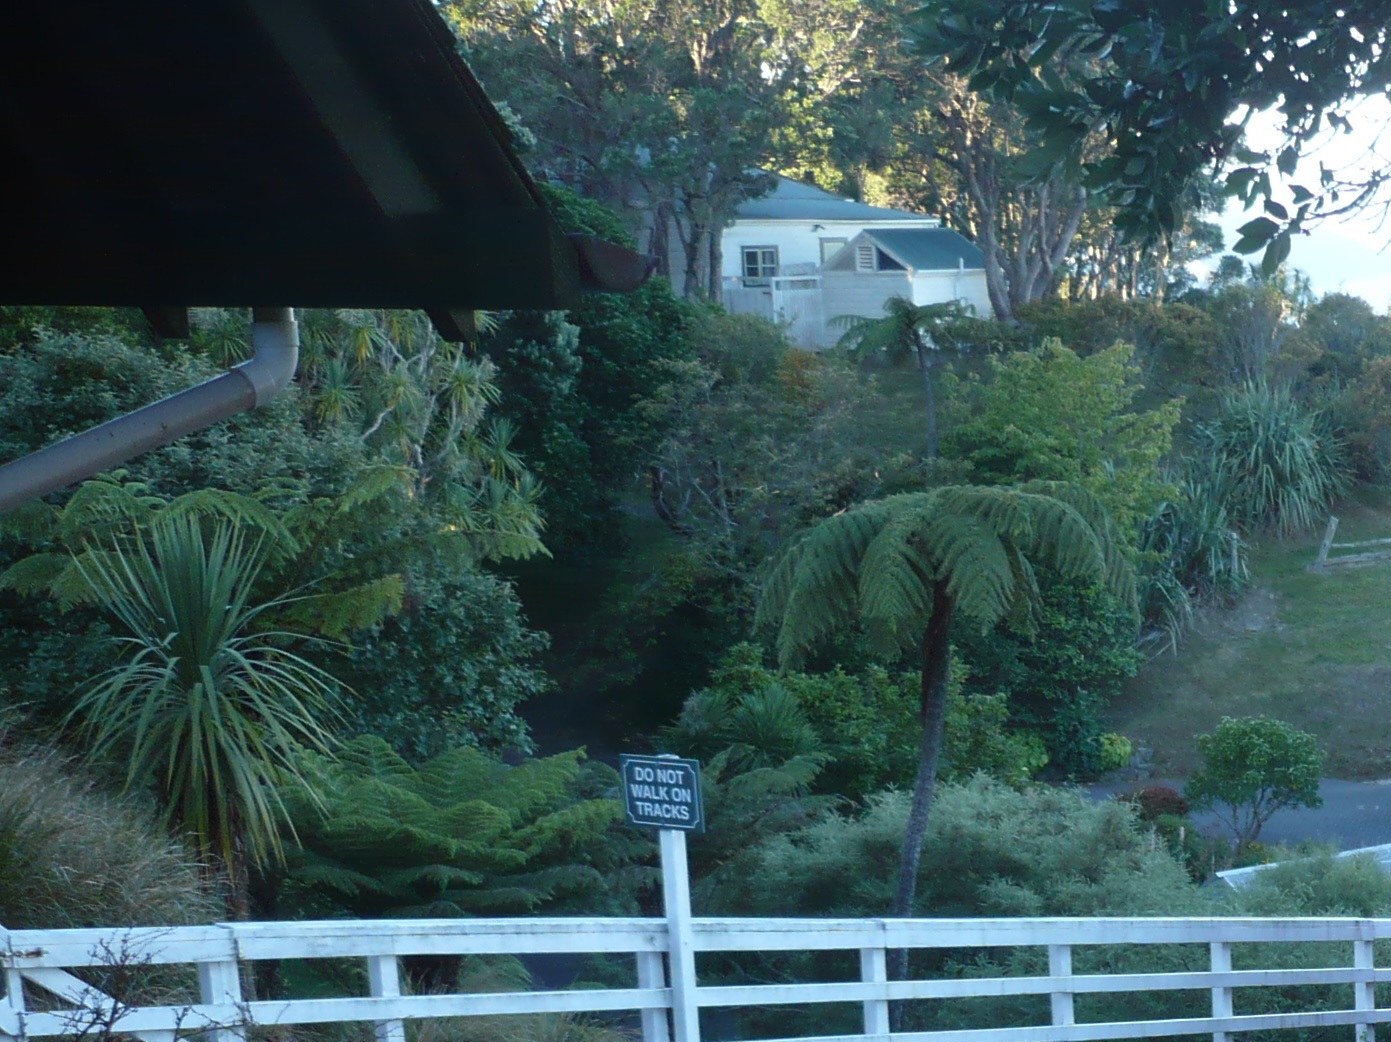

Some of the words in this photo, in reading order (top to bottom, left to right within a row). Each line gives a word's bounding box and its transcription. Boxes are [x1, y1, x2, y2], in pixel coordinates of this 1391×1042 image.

[634, 767, 654, 782] DO
[657, 769, 684, 785] NOT
[630, 783, 669, 801] WALK
[671, 787, 692, 803] ON
[635, 801, 690, 820] TRACKS
